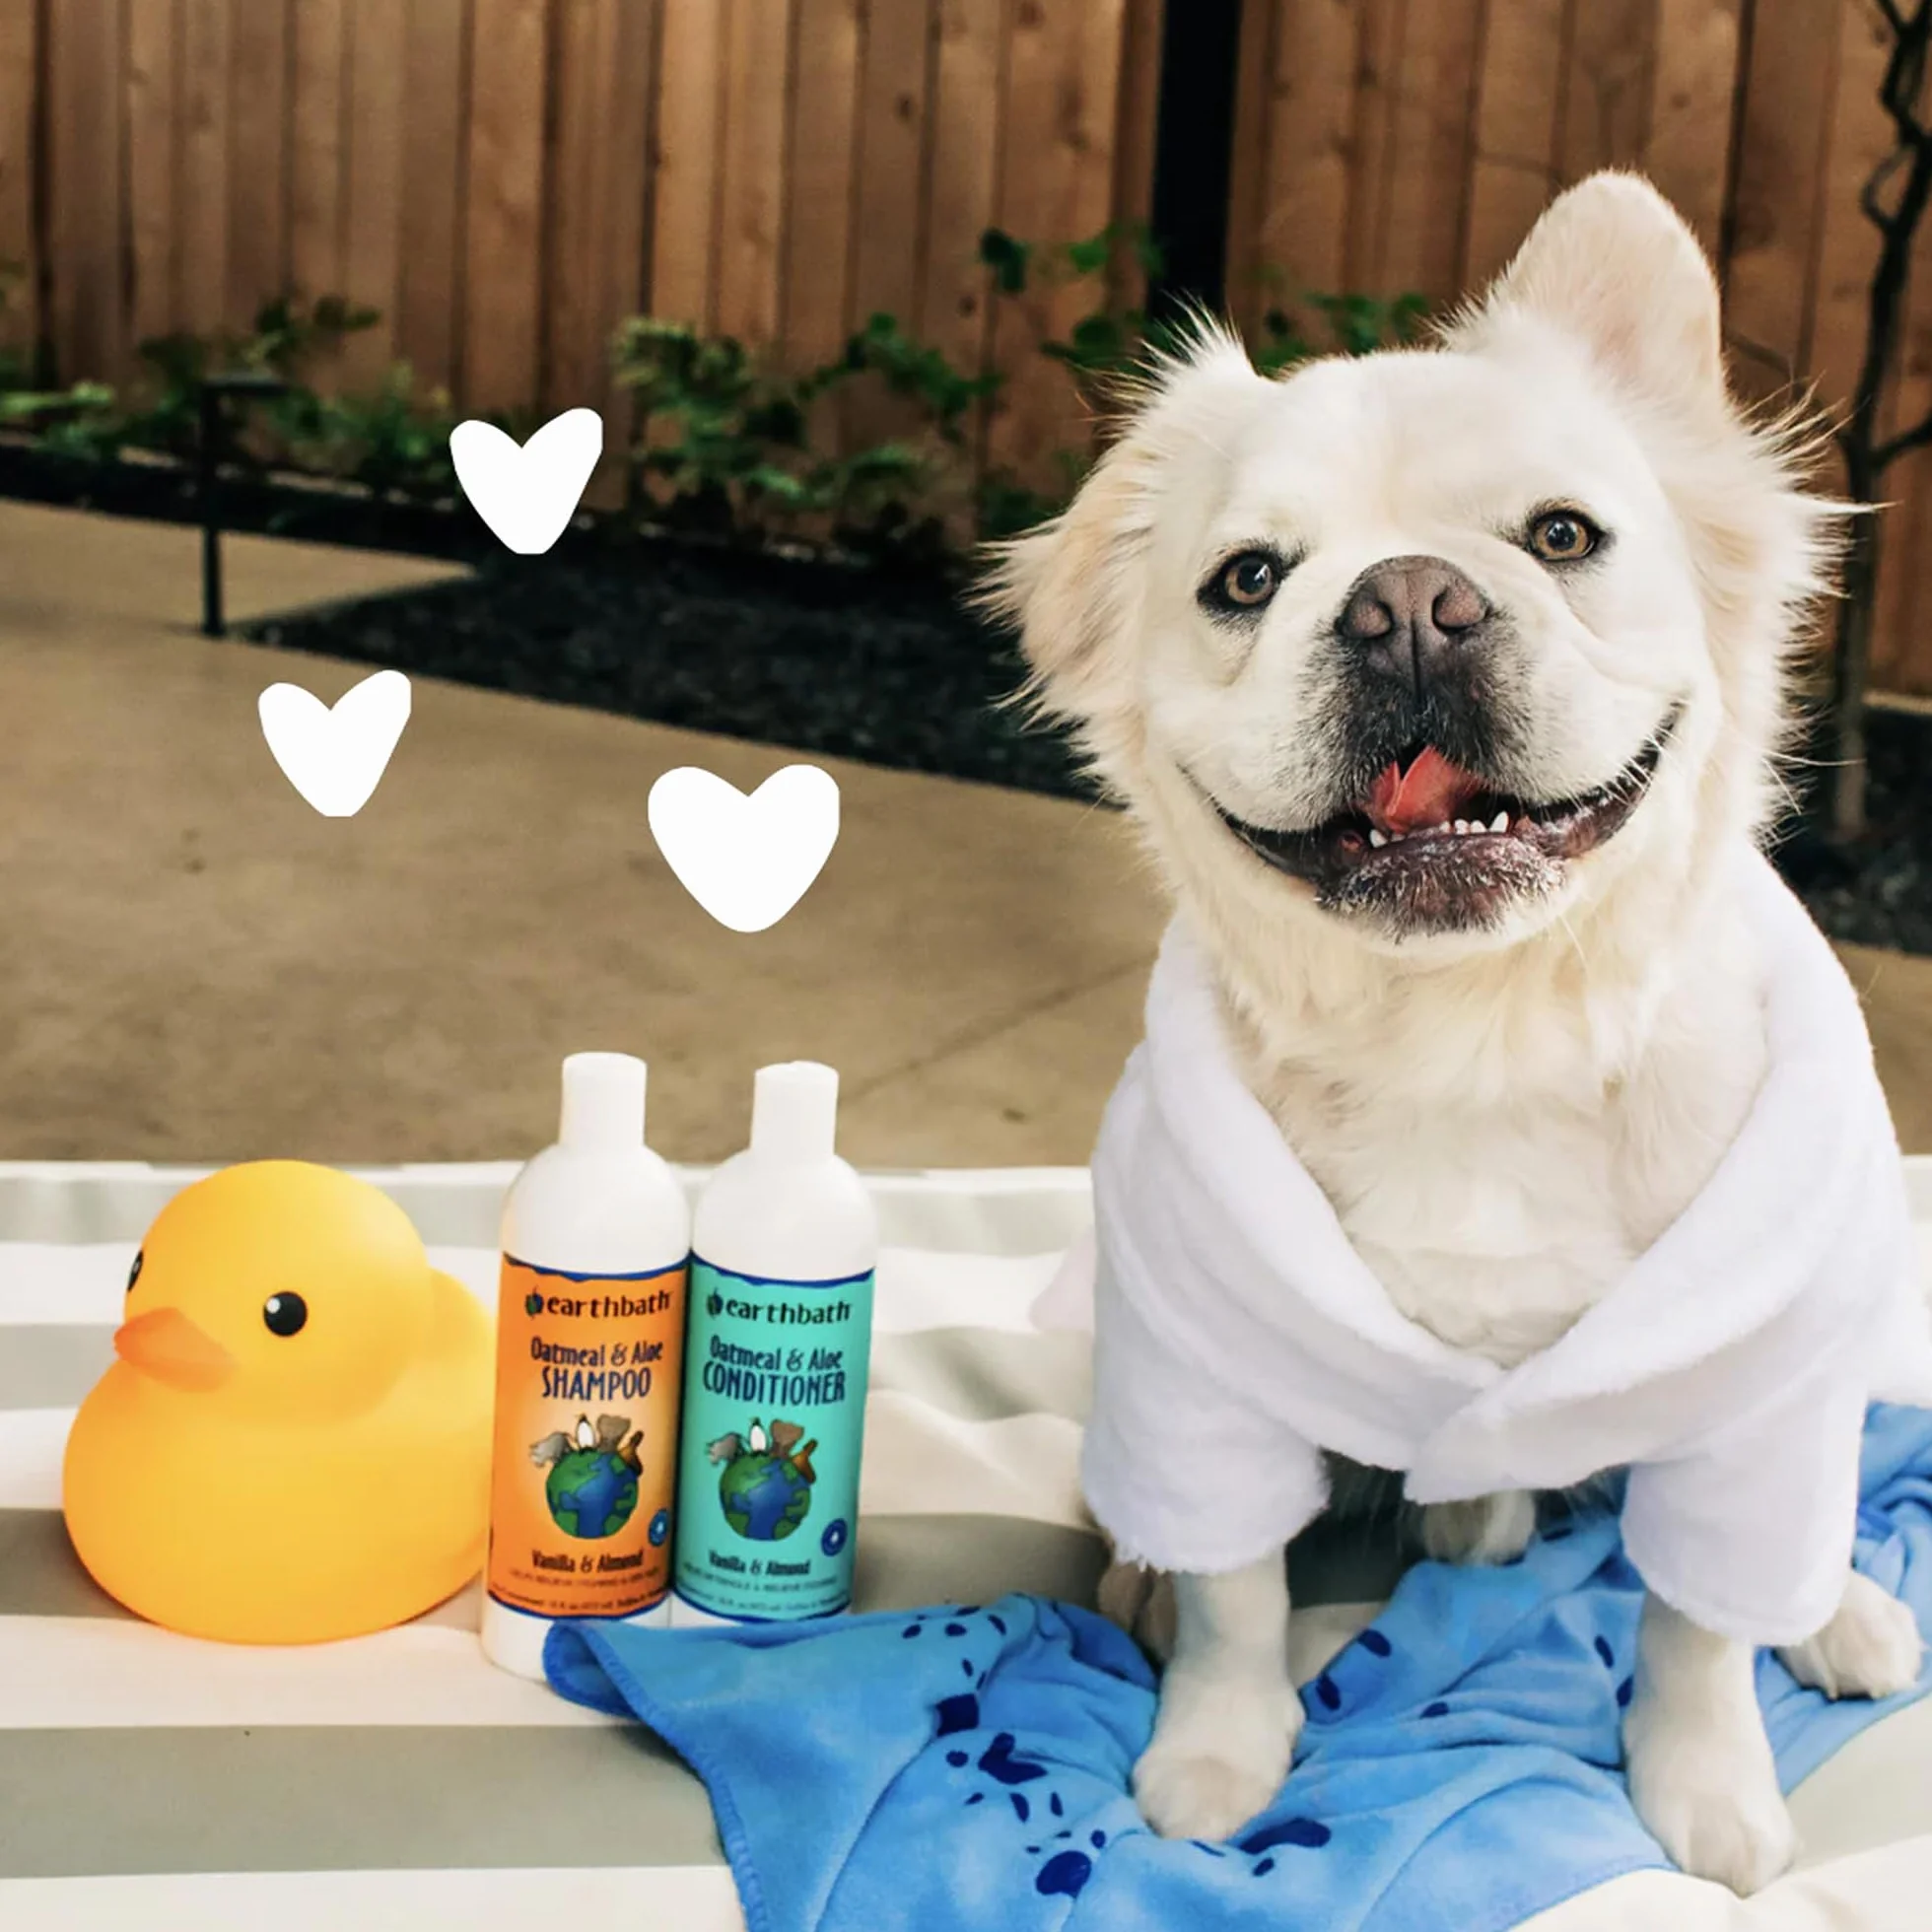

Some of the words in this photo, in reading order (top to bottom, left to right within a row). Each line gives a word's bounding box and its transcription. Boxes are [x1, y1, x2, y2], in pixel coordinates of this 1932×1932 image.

[546, 1289, 673, 1319] earthbath
[725, 1299, 853, 1325] earthbath
[530, 1336, 605, 1367] Oatmeal
[610, 1343, 629, 1367] &
[631, 1340, 663, 1365] Aloe
[710, 1334, 782, 1371] Oatmeal
[786, 1348, 804, 1372] &
[807, 1346, 844, 1371] Aloe
[541, 1364, 652, 1401] SHAMPOO
[703, 1360, 846, 1407] CONDITIONER
